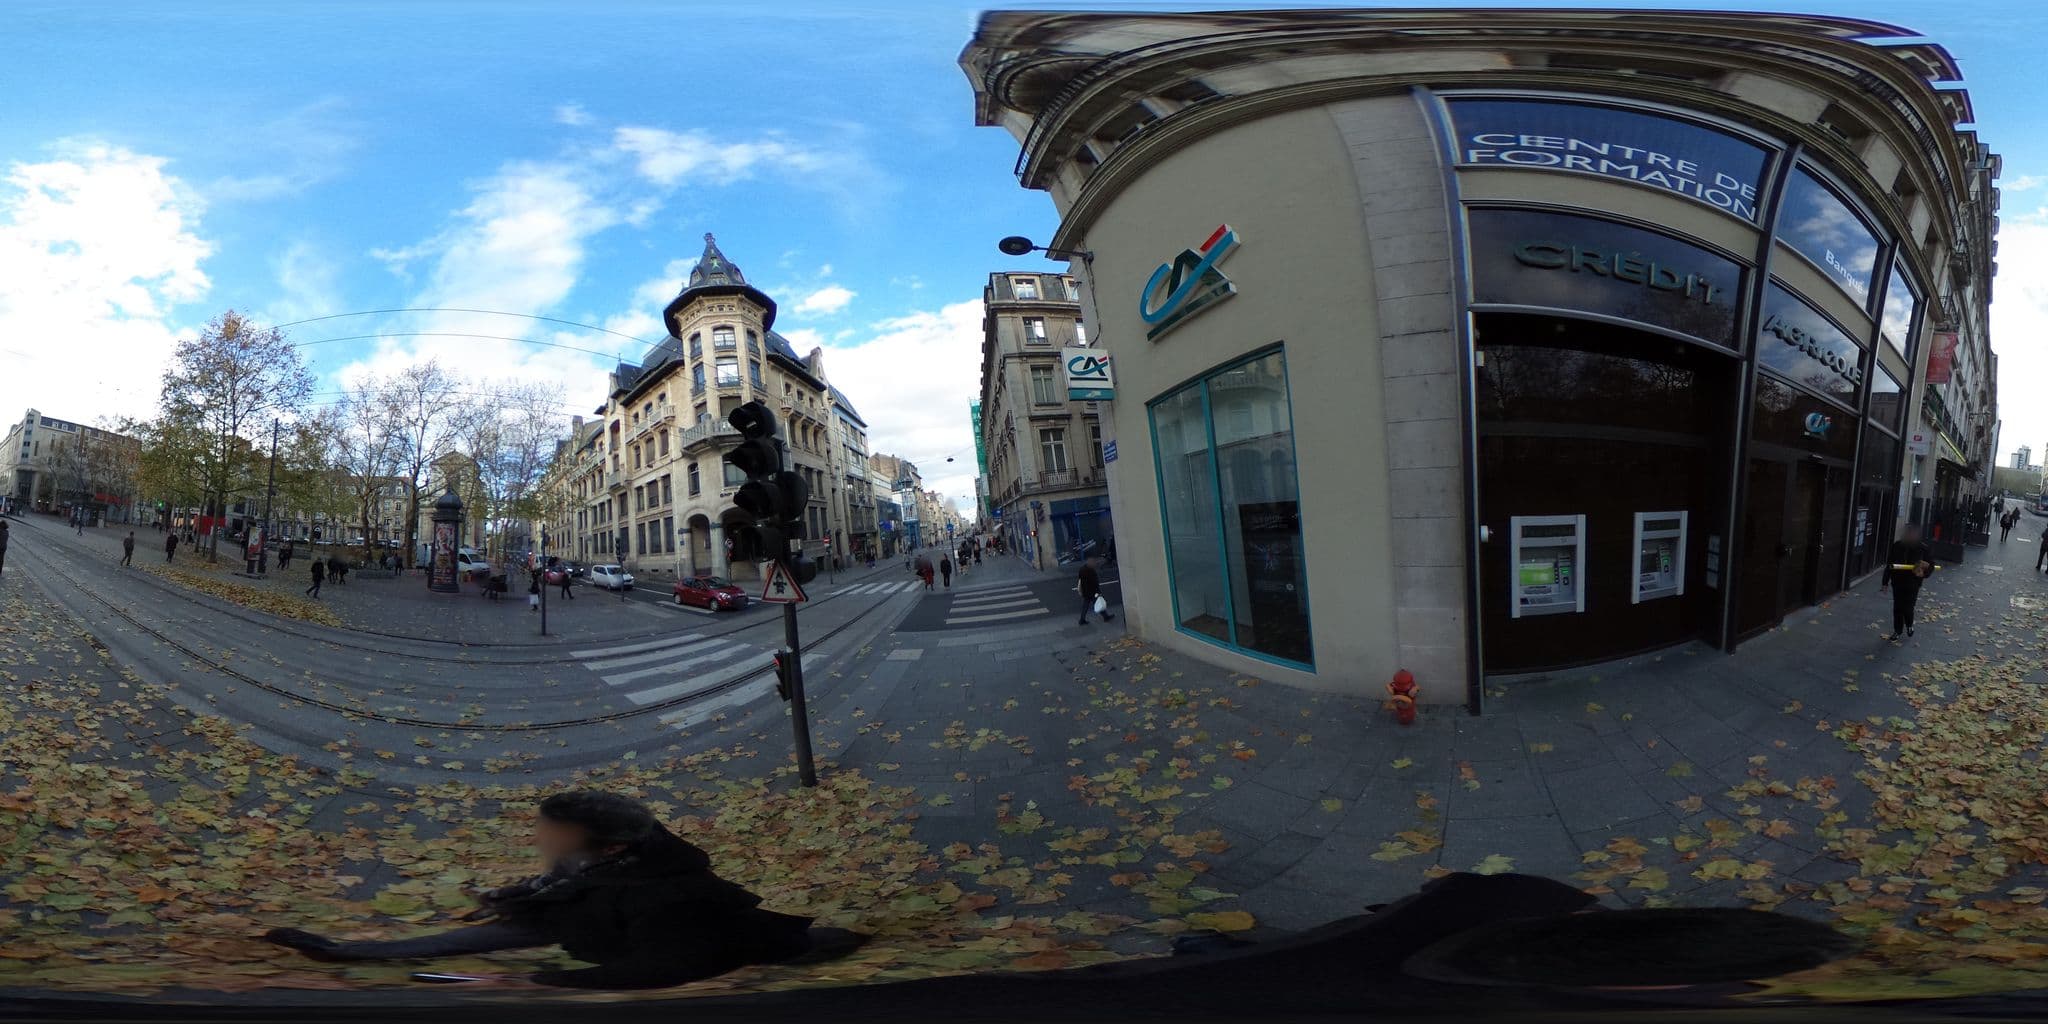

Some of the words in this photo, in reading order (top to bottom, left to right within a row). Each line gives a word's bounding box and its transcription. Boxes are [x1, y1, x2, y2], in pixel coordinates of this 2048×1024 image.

[1468, 149, 1757, 220] FORMATION
[1472, 133, 1698, 176] CENTRE
[1714, 172, 1756, 201] DE
[1825, 249, 1865, 294] Banque
[1068, 355, 1109, 376] CA
[1763, 314, 1863, 386] AGRICOLE
